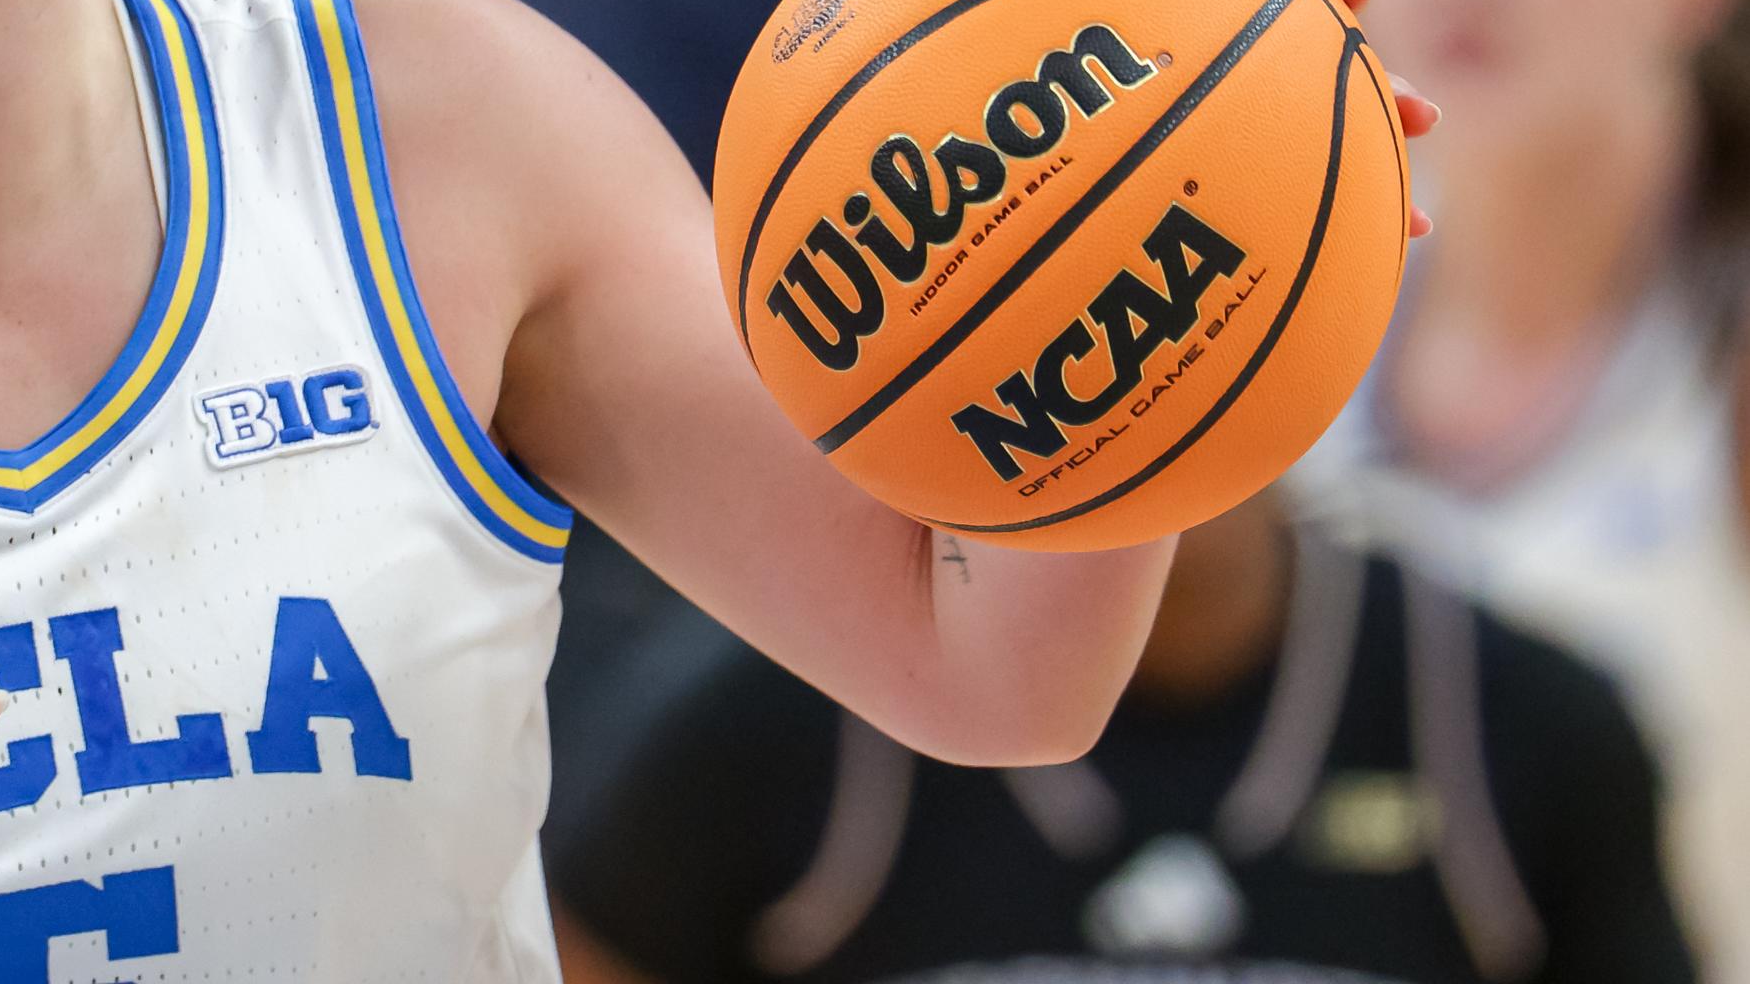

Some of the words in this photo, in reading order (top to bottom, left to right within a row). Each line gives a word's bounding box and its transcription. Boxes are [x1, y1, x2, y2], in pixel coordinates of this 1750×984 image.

[766, 23, 1159, 372] Wilson
[909, 249, 969, 317] INDOOR
[970, 196, 1022, 248] GAME
[1024, 155, 1074, 197] BALL
[950, 200, 1248, 483] NCAA
[1017, 423, 1131, 498] OFFICIAL
[1129, 342, 1206, 419] GAME
[1203, 267, 1267, 341] BALL
